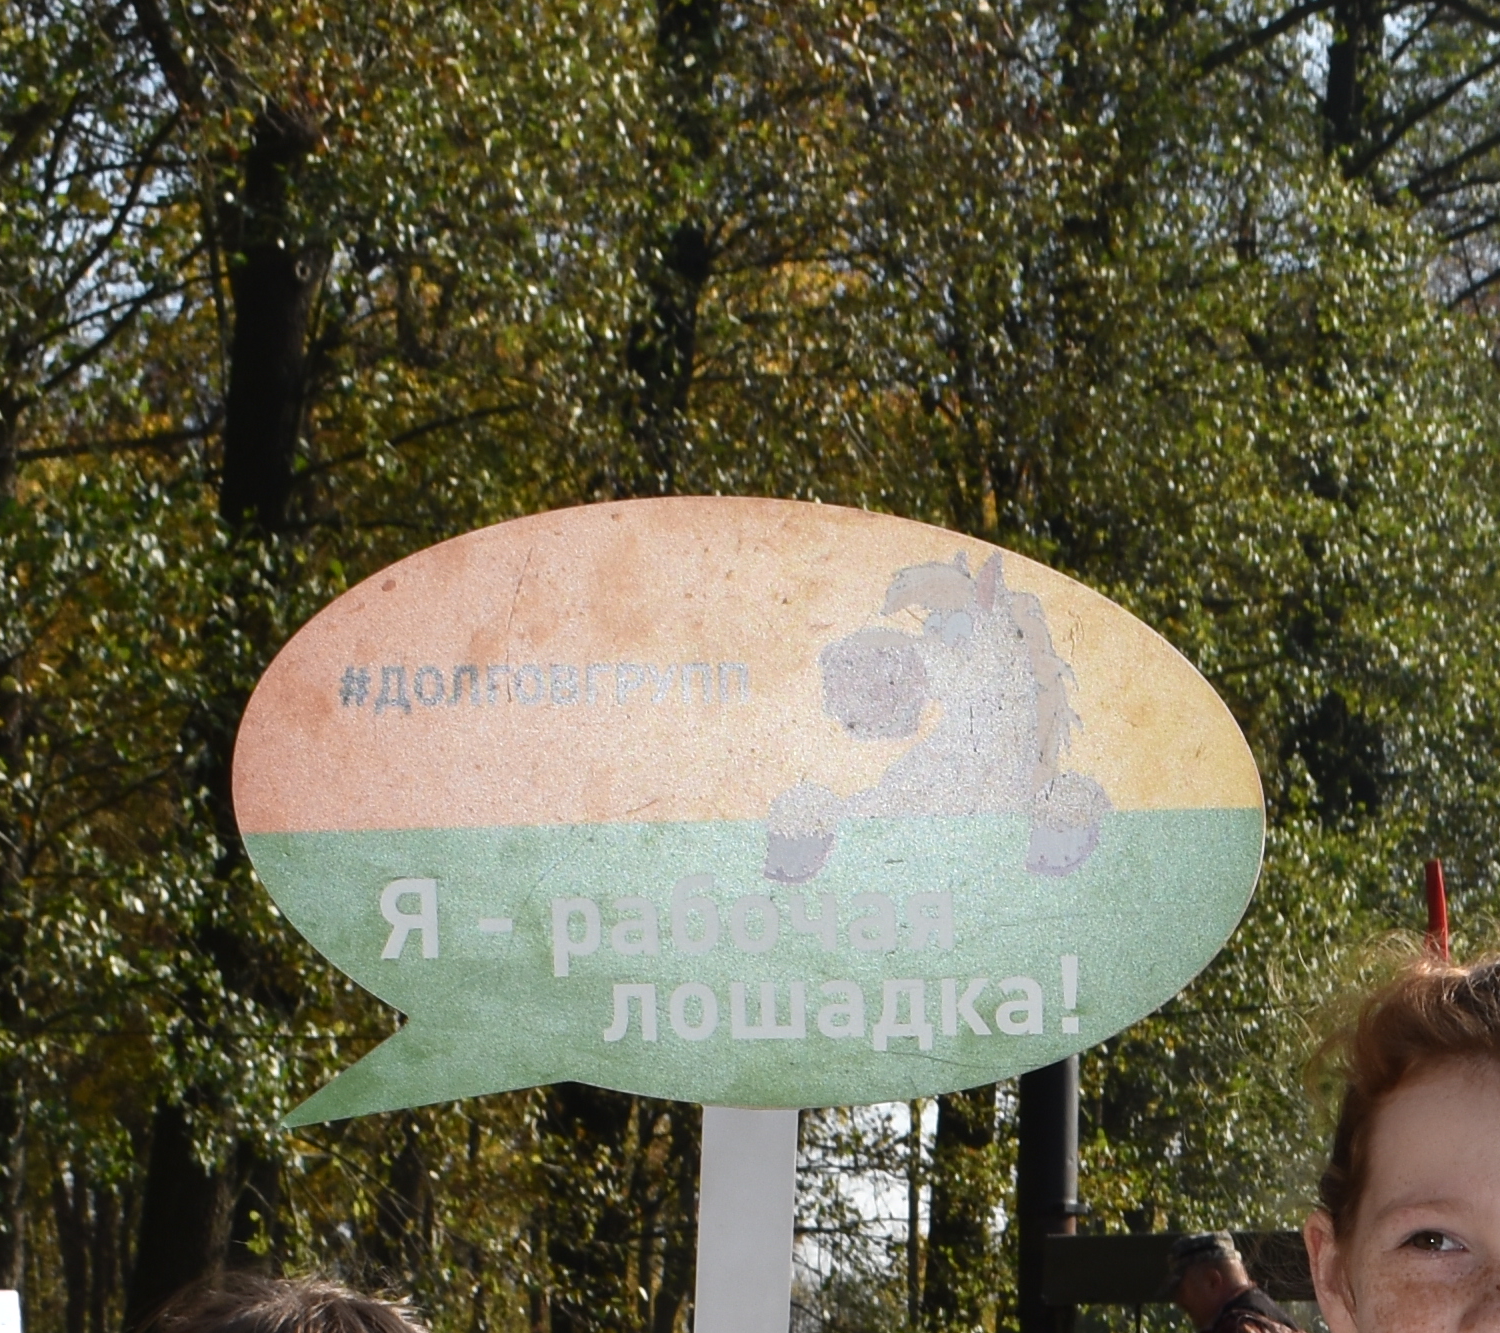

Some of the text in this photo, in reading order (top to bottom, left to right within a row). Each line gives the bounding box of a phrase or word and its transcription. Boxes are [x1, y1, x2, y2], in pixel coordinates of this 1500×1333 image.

[337, 660, 751, 715] #ДОЛГОВГРУПП
[378, 877, 440, 960] Я
[551, 872, 956, 978] рабочая
[603, 955, 1081, 1053] лошадка!
